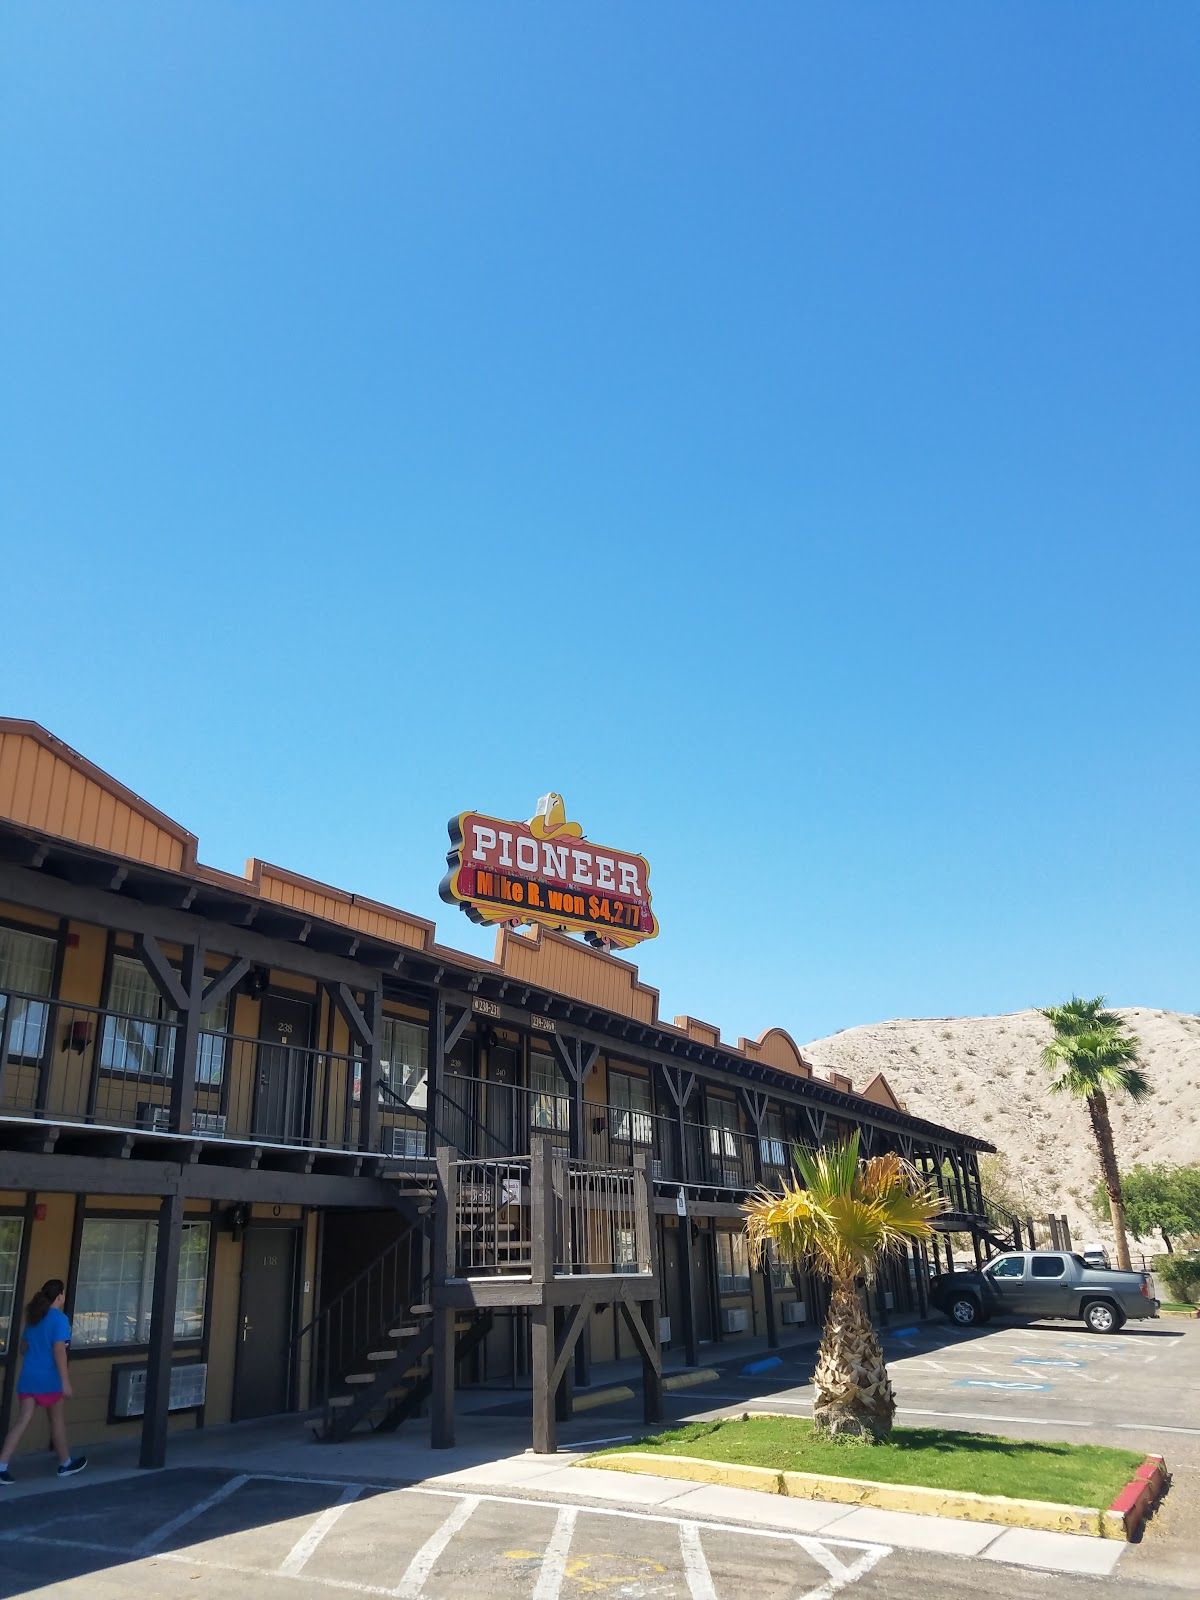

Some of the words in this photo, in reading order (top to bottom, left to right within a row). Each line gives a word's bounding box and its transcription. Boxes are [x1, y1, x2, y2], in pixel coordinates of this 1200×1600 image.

[472, 824, 642, 897] PIONEER
[477, 870, 524, 903] Mike
[527, 881, 545, 908] R.
[547, 890, 585, 916] won
[588, 895, 640, 927] $4,277
[278, 1022, 293, 1033] 238
